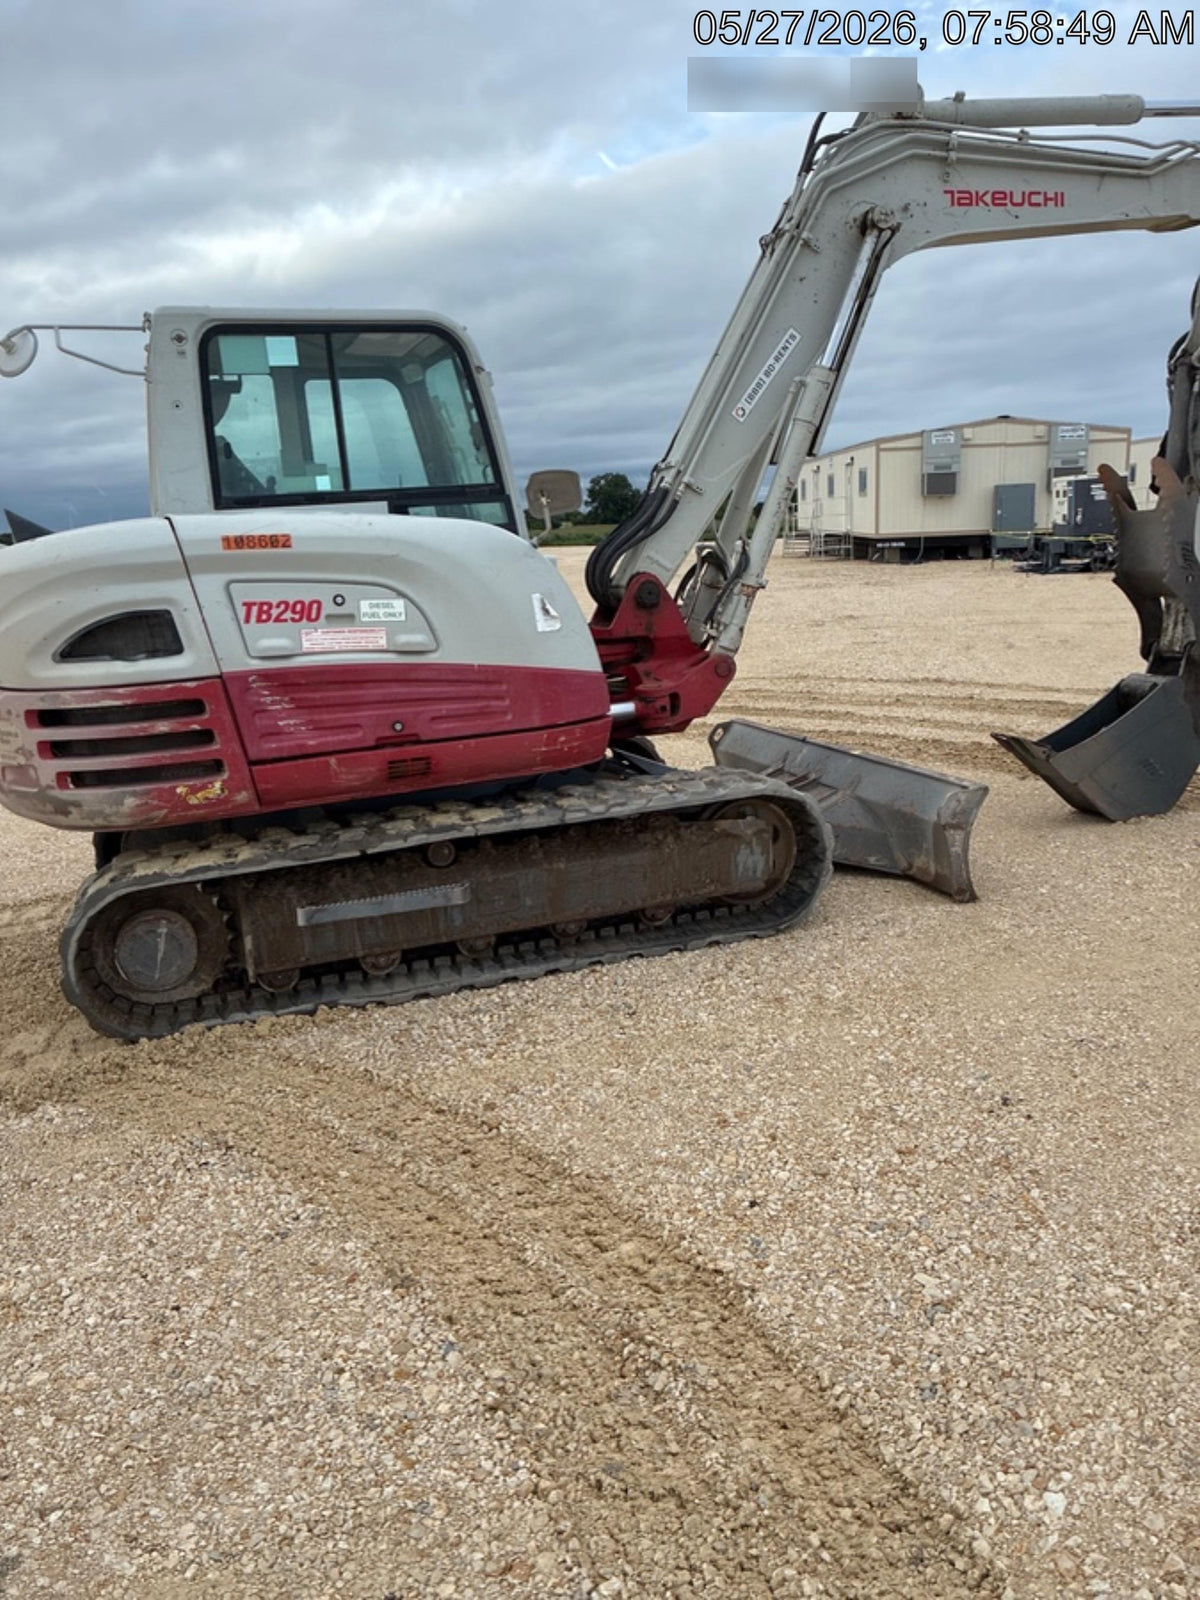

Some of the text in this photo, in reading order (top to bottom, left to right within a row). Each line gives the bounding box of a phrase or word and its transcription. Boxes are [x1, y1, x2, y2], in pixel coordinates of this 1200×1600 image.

[943, 190, 1065, 207] TAKEUCHI
[241, 599, 322, 624] TB290
[362, 611, 381, 619] FUEL
